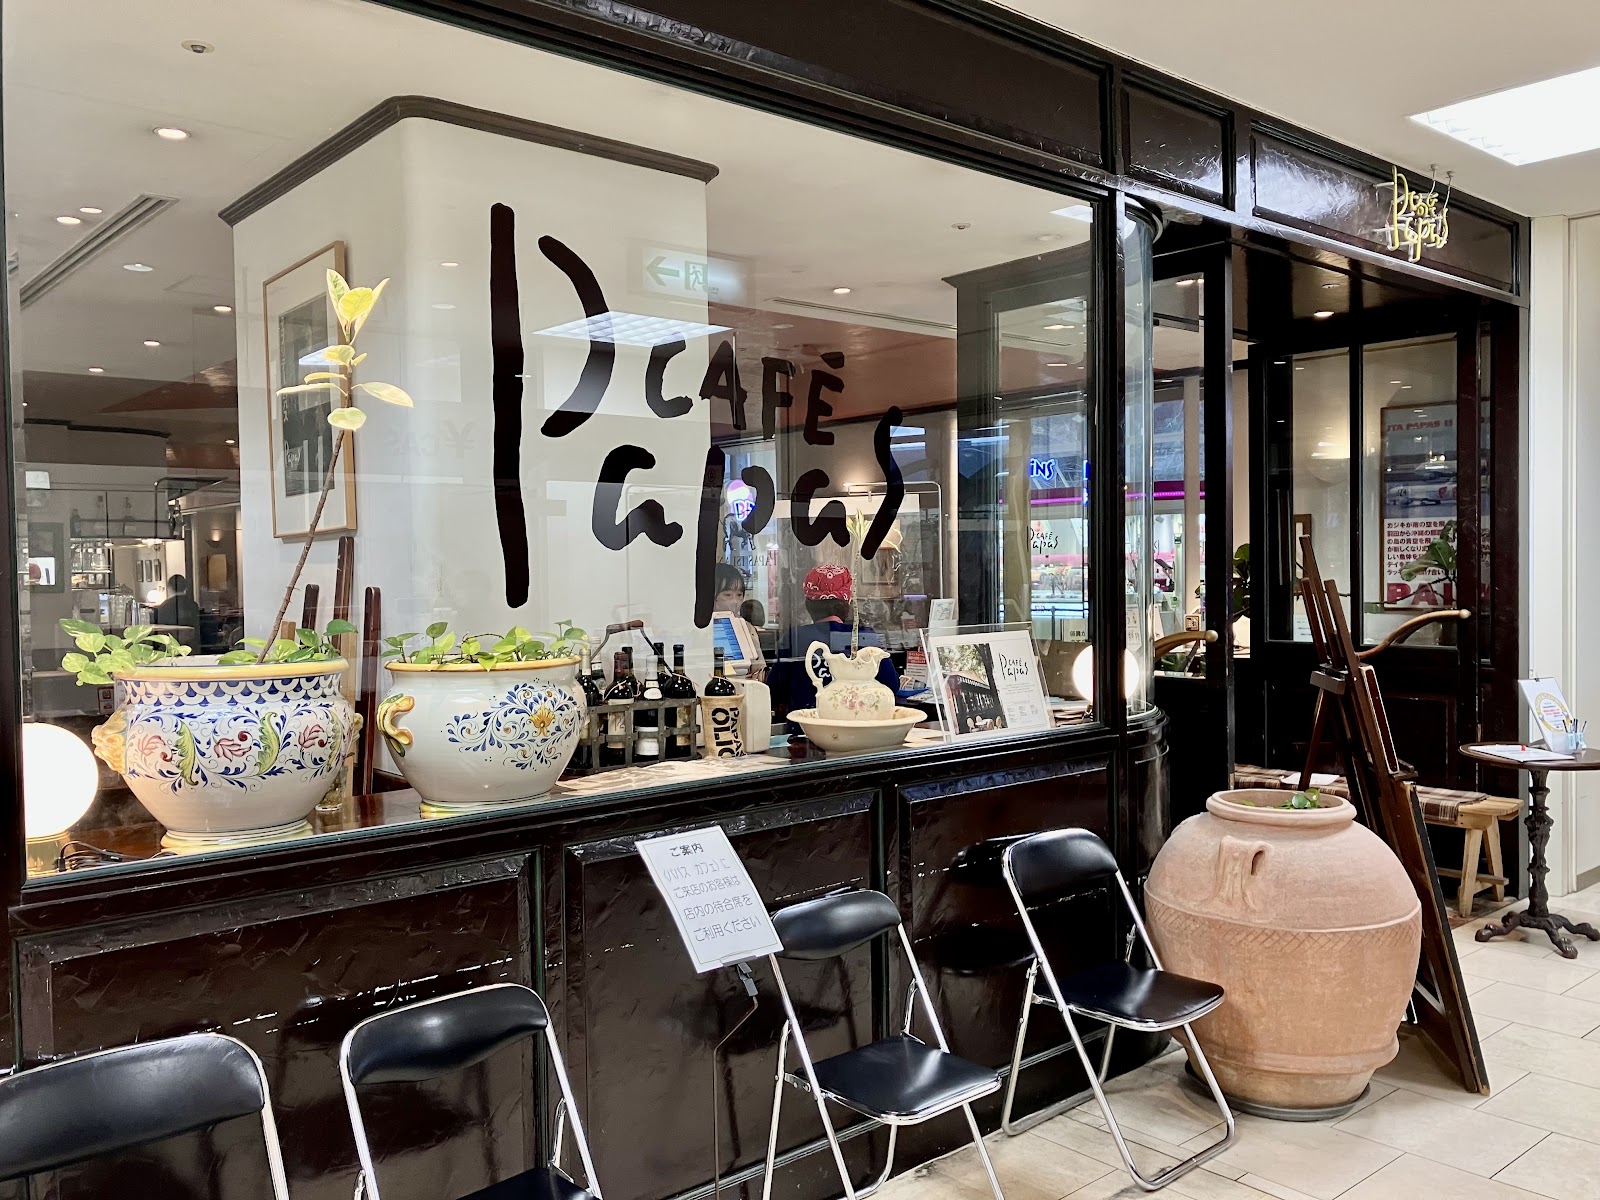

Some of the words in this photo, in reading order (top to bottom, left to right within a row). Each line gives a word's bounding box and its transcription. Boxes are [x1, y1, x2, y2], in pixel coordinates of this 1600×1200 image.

[669, 842, 704, 857] ご案内
[673, 875, 741, 899] ご来店のお客様は
[683, 893, 753, 921] 店内の待合席を
[693, 915, 761, 942] ご利用ください
